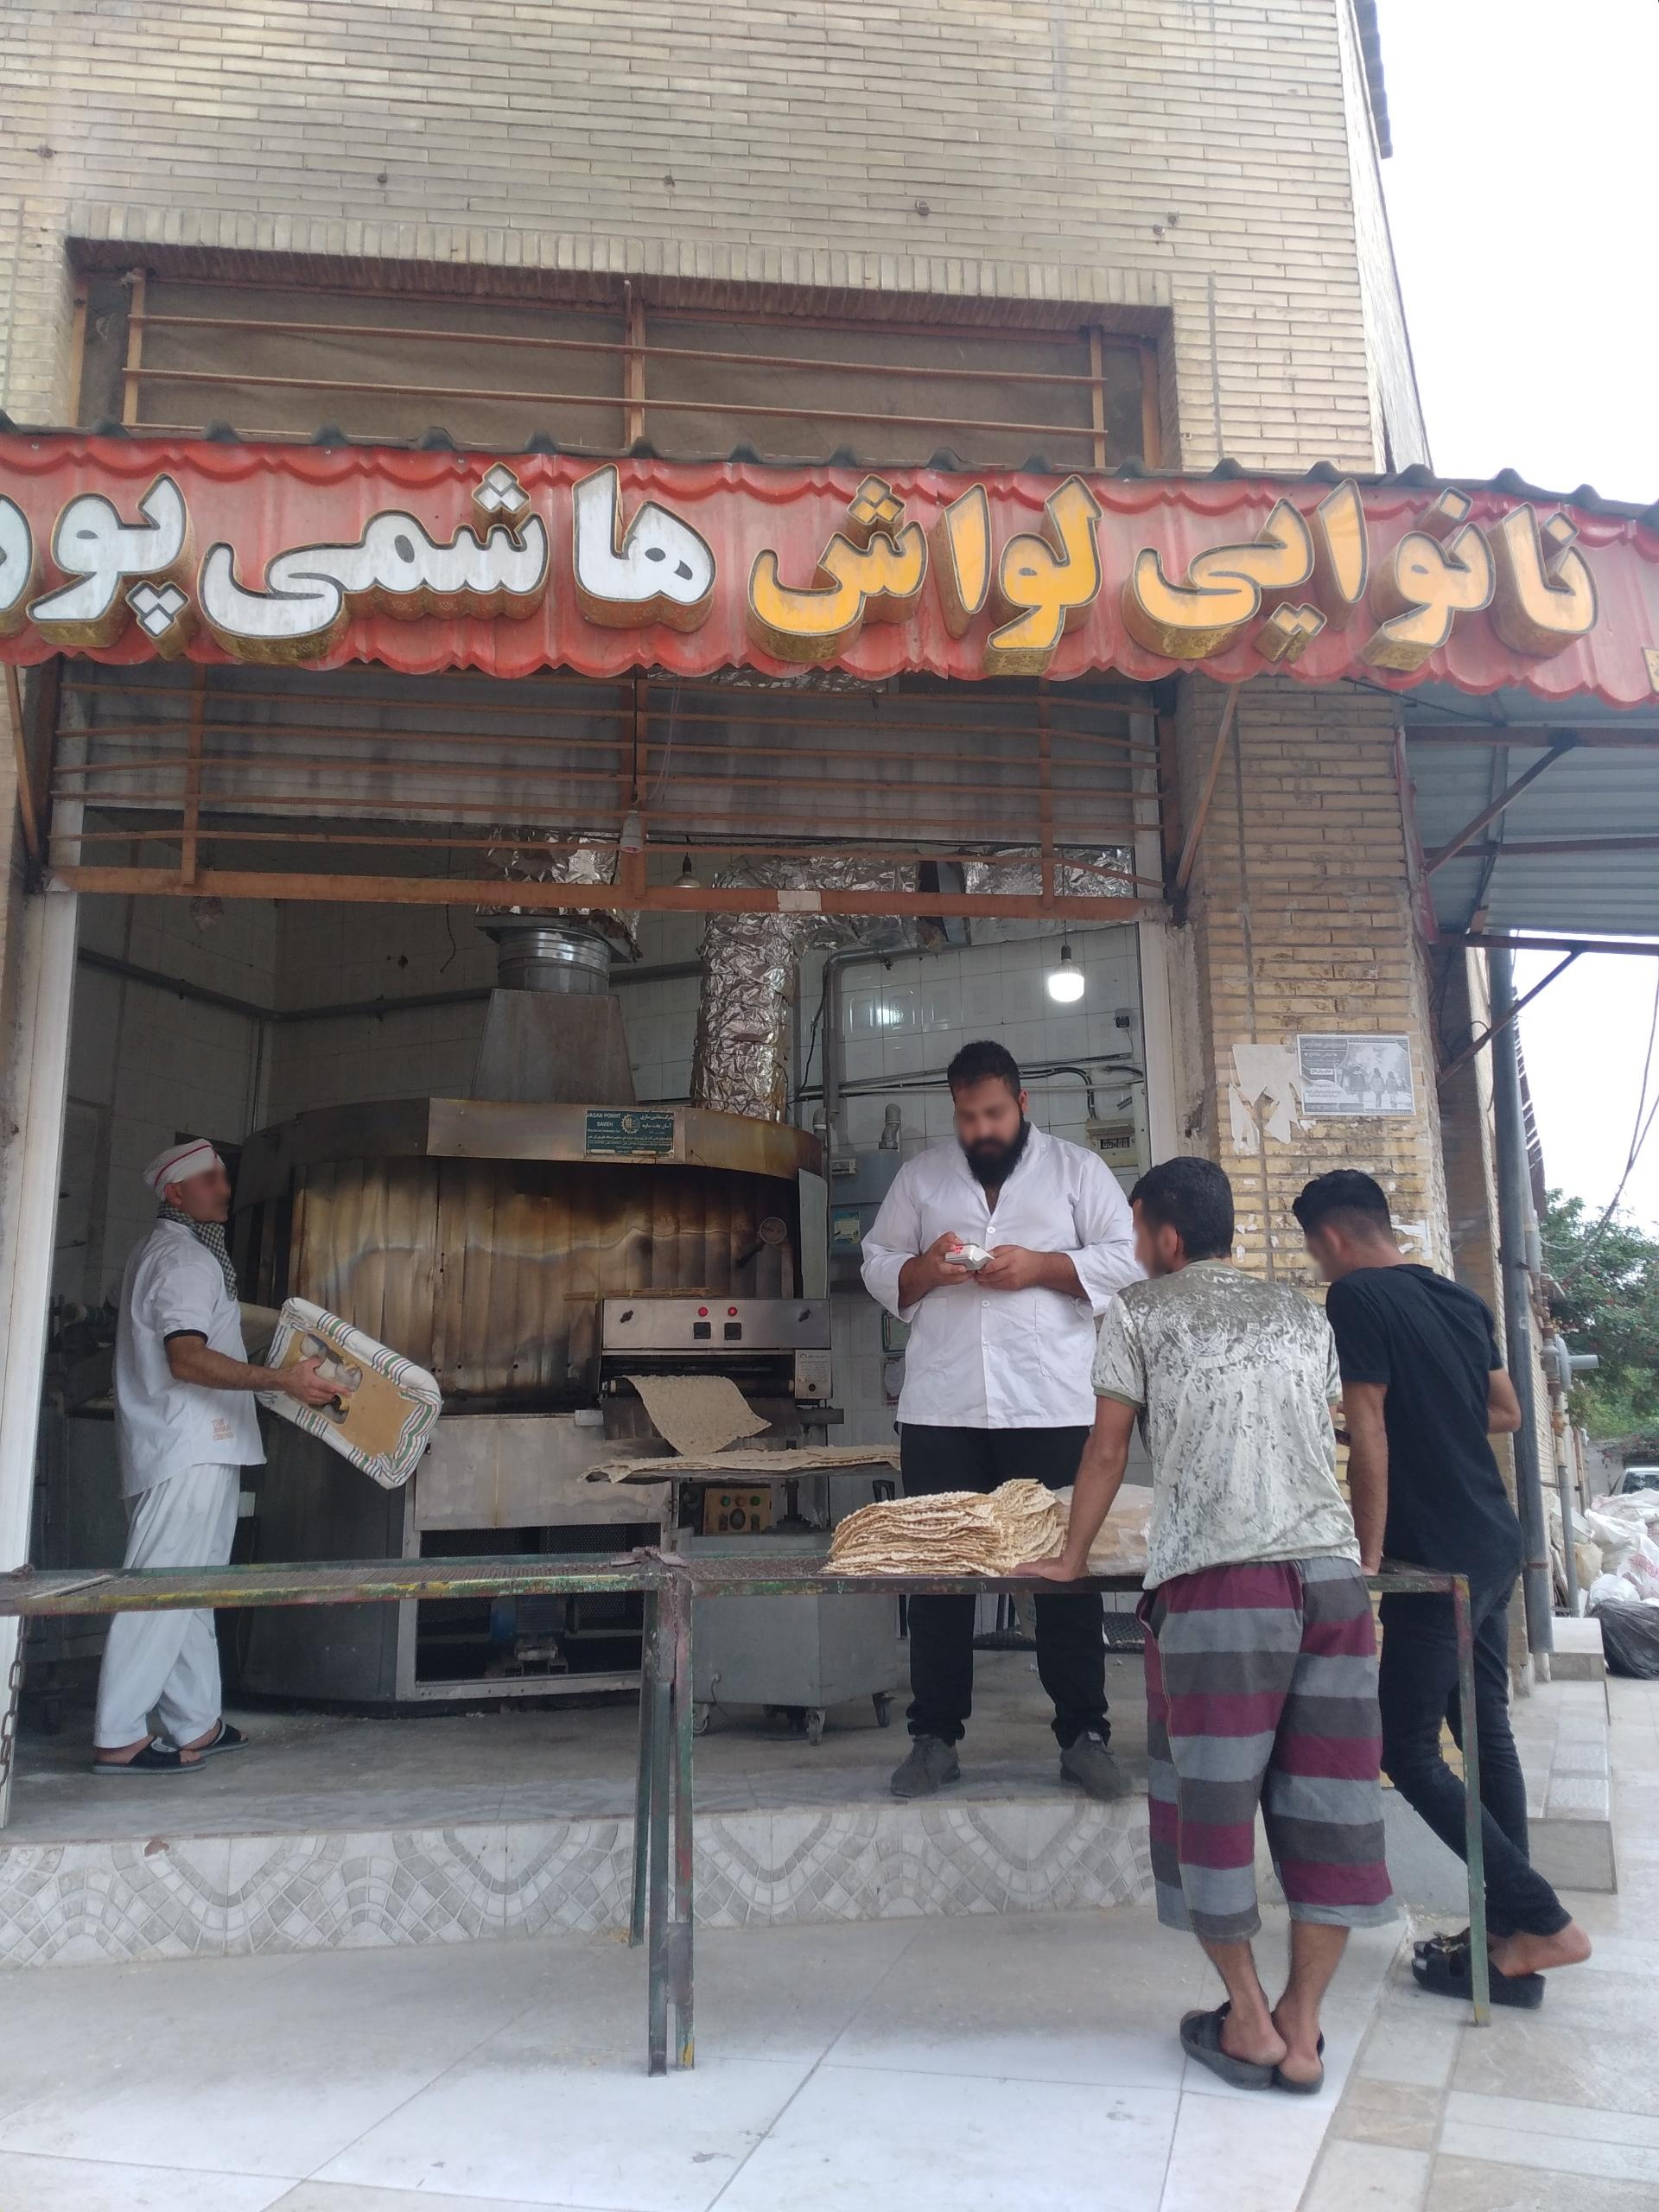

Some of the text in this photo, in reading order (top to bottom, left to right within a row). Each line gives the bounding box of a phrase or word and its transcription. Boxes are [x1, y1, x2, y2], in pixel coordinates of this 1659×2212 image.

[197, 461, 717, 640] هاشمی
[747, 472, 1104, 652] لواش
[1130, 478, 1600, 652] نانوایی
